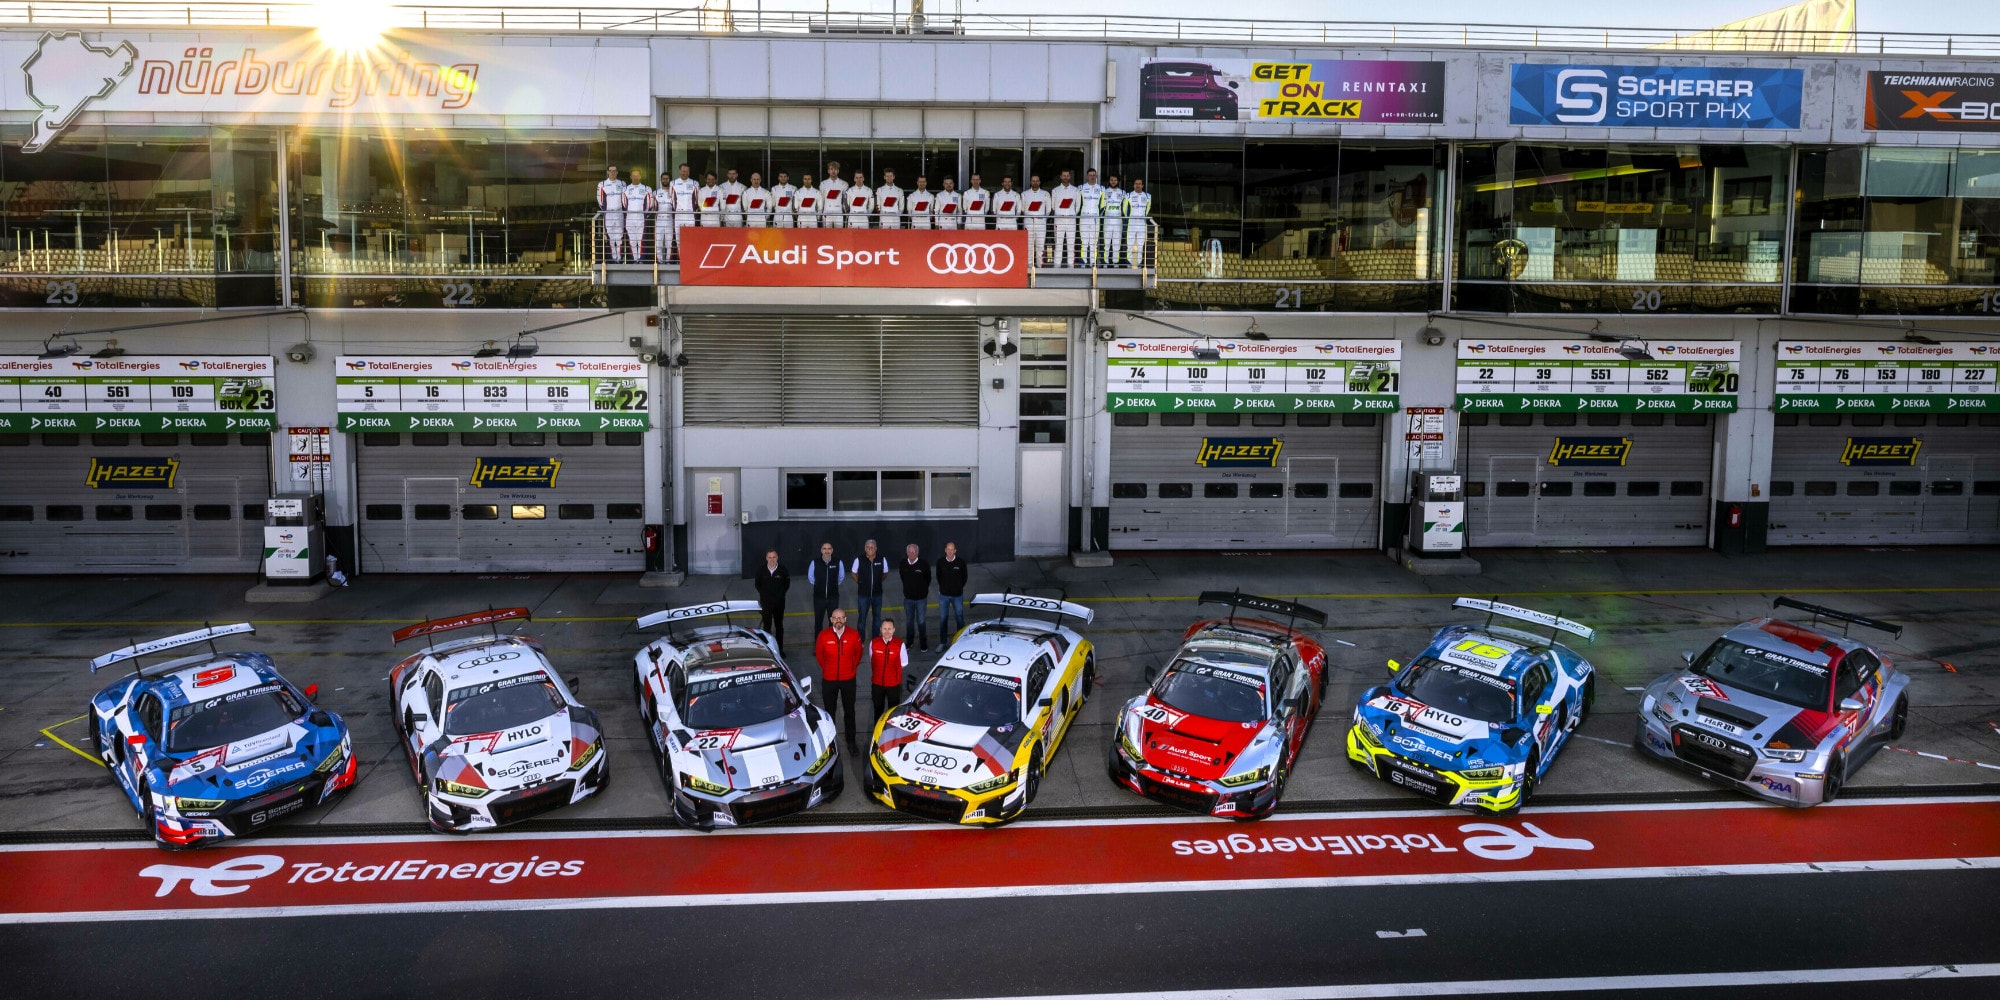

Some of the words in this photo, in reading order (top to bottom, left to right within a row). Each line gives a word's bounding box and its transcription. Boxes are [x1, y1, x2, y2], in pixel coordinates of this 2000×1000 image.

[138, 47, 479, 109] nürburgring
[1253, 65, 1309, 80] GET
[1342, 81, 1427, 93] RENNTAXI
[1618, 76, 1753, 97] SCHERER
[1884, 76, 1994, 87] TEICHMANNRACING
[1282, 83, 1322, 98] ON
[1263, 101, 1359, 117] TRACK
[1381, 111, 1439, 119] get-on-track.de
[1617, 102, 1697, 118] SPORT
[1706, 103, 1751, 119] PHX
[739, 244, 807, 265] Audi
[817, 244, 900, 270] Sport
[46, 282, 78, 305] 23
[442, 283, 474, 306] 22
[1275, 287, 1301, 308] 21
[1632, 290, 1661, 311] 20
[1138, 343, 1198, 353] TotalEnergies
[1237, 344, 1297, 354] TotalEnergies
[1335, 345, 1395, 355] TotalEnergies
[1488, 345, 1546, 355] TotalEnergies
[1676, 346, 1734, 356] TotalEnergies
[1805, 346, 1861, 356] TotalEnergies
[1897, 346, 1953, 356] TotalEnergies
[95, 361, 160, 372] TotalEnergies
[201, 361, 267, 372] TotalEnergies
[368, 361, 433, 372] TotalEnergies
[473, 361, 537, 372] TotalEnergies
[577, 362, 642, 373] TotalEnergies
[1130, 367, 1145, 378] 74
[1187, 367, 1208, 379] 100
[1248, 368, 1266, 380] 101
[1306, 368, 1326, 380] 102
[1479, 368, 1494, 380] 22
[1536, 368, 1551, 380] 39
[1591, 369, 1611, 380] 551
[1646, 370, 1668, 380] 562
[1791, 369, 1804, 380] 75
[1836, 369, 1849, 380] 76
[1878, 369, 1896, 380] 153
[1921, 369, 1940, 380] 180
[1964, 369, 1985, 380] 227
[1349, 382, 1370, 392] BOX
[1377, 373, 1399, 392] 21
[1689, 383, 1710, 393] BOX
[1713, 373, 1738, 393] 20
[45, 386, 62, 398] 40
[107, 386, 130, 398] 561
[171, 386, 194, 398] 109
[365, 386, 373, 397] 5
[425, 386, 439, 397] 16
[483, 386, 508, 398] 833
[547, 386, 569, 398] 816
[220, 400, 243, 410] BOX
[246, 389, 274, 410] 23
[594, 400, 617, 410] BOX
[619, 390, 648, 411] 22
[1127, 399, 1156, 407] DEKRA
[1187, 399, 1216, 407] DEKRA
[1246, 400, 1275, 408] DEKRA
[1306, 400, 1335, 408] DEKRA
[1365, 400, 1394, 409] DEKRA
[1475, 400, 1504, 408] DEKRA
[1533, 400, 1561, 408] DEKRA
[1590, 400, 1618, 408] DEKRA
[1648, 400, 1676, 409] DEKRA
[1705, 400, 1733, 409] DEKRA
[1792, 399, 1820, 408] DEKRA
[1848, 399, 1875, 408] DEKRA
[1903, 399, 1930, 408] DEKRA
[1959, 399, 1986, 408] DEKRA
[44, 419, 76, 427] DEKRA
[109, 419, 141, 427] DEKRA
[175, 419, 207, 427] DEKRA
[239, 419, 271, 427] DEKRA
[359, 418, 391, 427] DEKRA
[423, 418, 454, 427] DEKRA
[486, 418, 517, 427] DEKRA
[550, 418, 581, 427] DEKRA
[613, 418, 644, 427] DEKRA
[1205, 445, 1272, 460] HAZET
[1558, 445, 1620, 460] HAZET
[1849, 445, 1914, 461] HAZET
[96, 465, 170, 481] HAZET
[480, 464, 552, 480] HAZET
[431, 619, 467, 631] Audi
[471, 610, 517, 623] Sport
[1532, 612, 1586, 631] WIZARD
[1451, 639, 1511, 660] 16
[1765, 652, 1788, 663] GRAN
[1789, 659, 1827, 674] TURISMO
[193, 663, 237, 689] 5
[498, 678, 517, 687] GRAN
[517, 673, 546, 683] TURISMO
[736, 675, 753, 684] GRAN
[754, 672, 781, 680] TURISMO
[971, 673, 989, 682] GRAN
[990, 676, 1019, 688] TURISMO
[1213, 670, 1233, 678] GRAN
[1233, 673, 1263, 686] TURISMO
[1459, 669, 1479, 678] GRAN
[1480, 675, 1512, 690] TURISMO
[225, 691, 248, 702] GRAN
[249, 684, 281, 696] TURISMO
[1384, 700, 1402, 712] 16
[1144, 709, 1166, 721] 40
[1424, 708, 1463, 727] HYLO
[900, 717, 921, 731] 39
[507, 725, 542, 742] HYLO
[463, 741, 470, 753] 1
[698, 736, 719, 750] 22
[1392, 735, 1454, 762] SCHERER
[1168, 745, 1187, 756] Audi
[1188, 750, 1212, 762] Sport
[191, 760, 206, 773] 5
[497, 757, 560, 778] SCHERER
[234, 761, 306, 790] SCHERER
[1172, 828, 1459, 860] TotalEnergies
[287, 858, 585, 885] TotalEnergies
